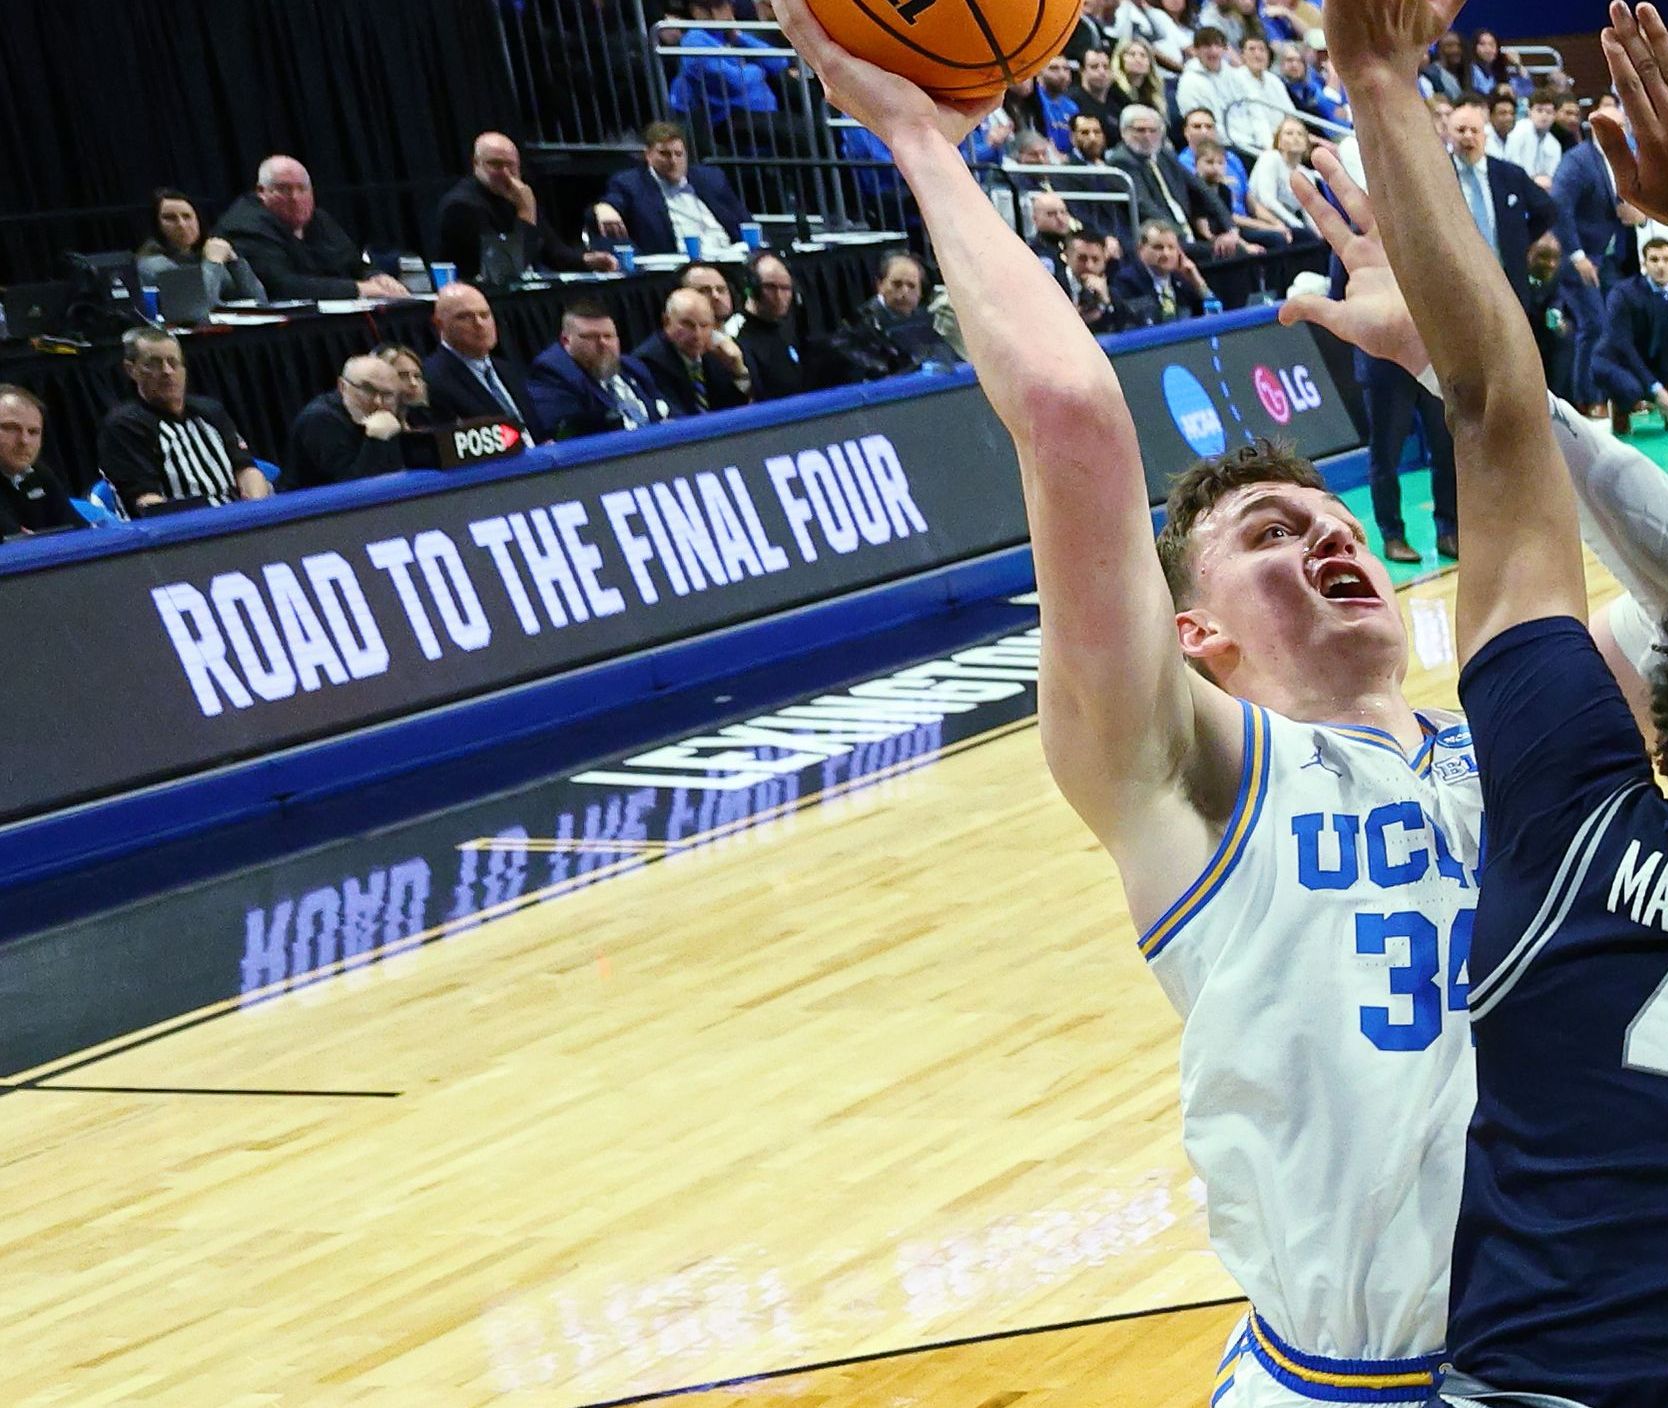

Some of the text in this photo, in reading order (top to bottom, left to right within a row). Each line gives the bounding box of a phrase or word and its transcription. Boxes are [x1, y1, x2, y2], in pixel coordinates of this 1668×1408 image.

[1278, 364, 1323, 414] LG
[453, 424, 508, 459] POSS
[151, 434, 928, 716] ROAD TO THE FINAL FOUR
